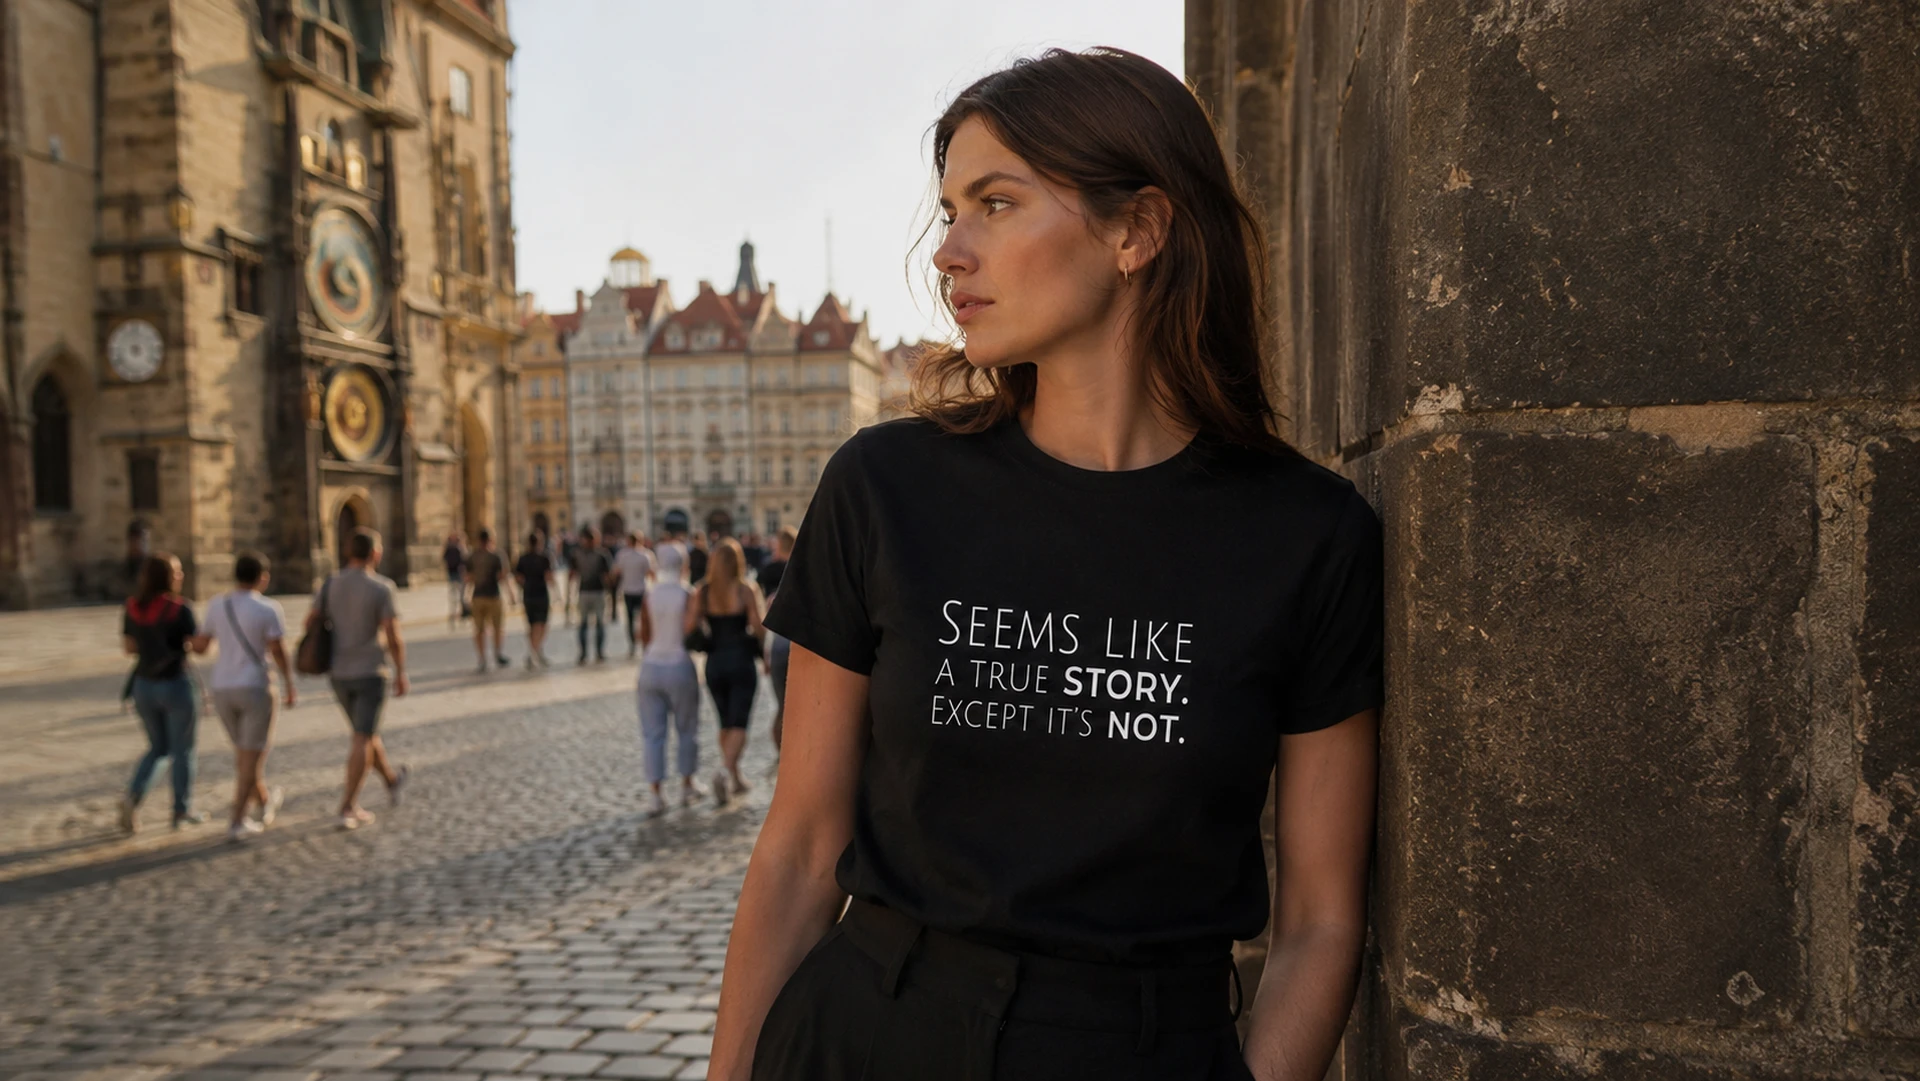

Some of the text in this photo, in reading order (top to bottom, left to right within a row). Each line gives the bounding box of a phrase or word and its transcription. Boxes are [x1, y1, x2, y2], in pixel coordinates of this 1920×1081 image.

[939, 600, 1193, 663] SEEMS LIKE
[935, 658, 1188, 704] A TRUE STORY.
[932, 695, 1034, 731] EXCEPT
[1108, 711, 1184, 744] NOT.
